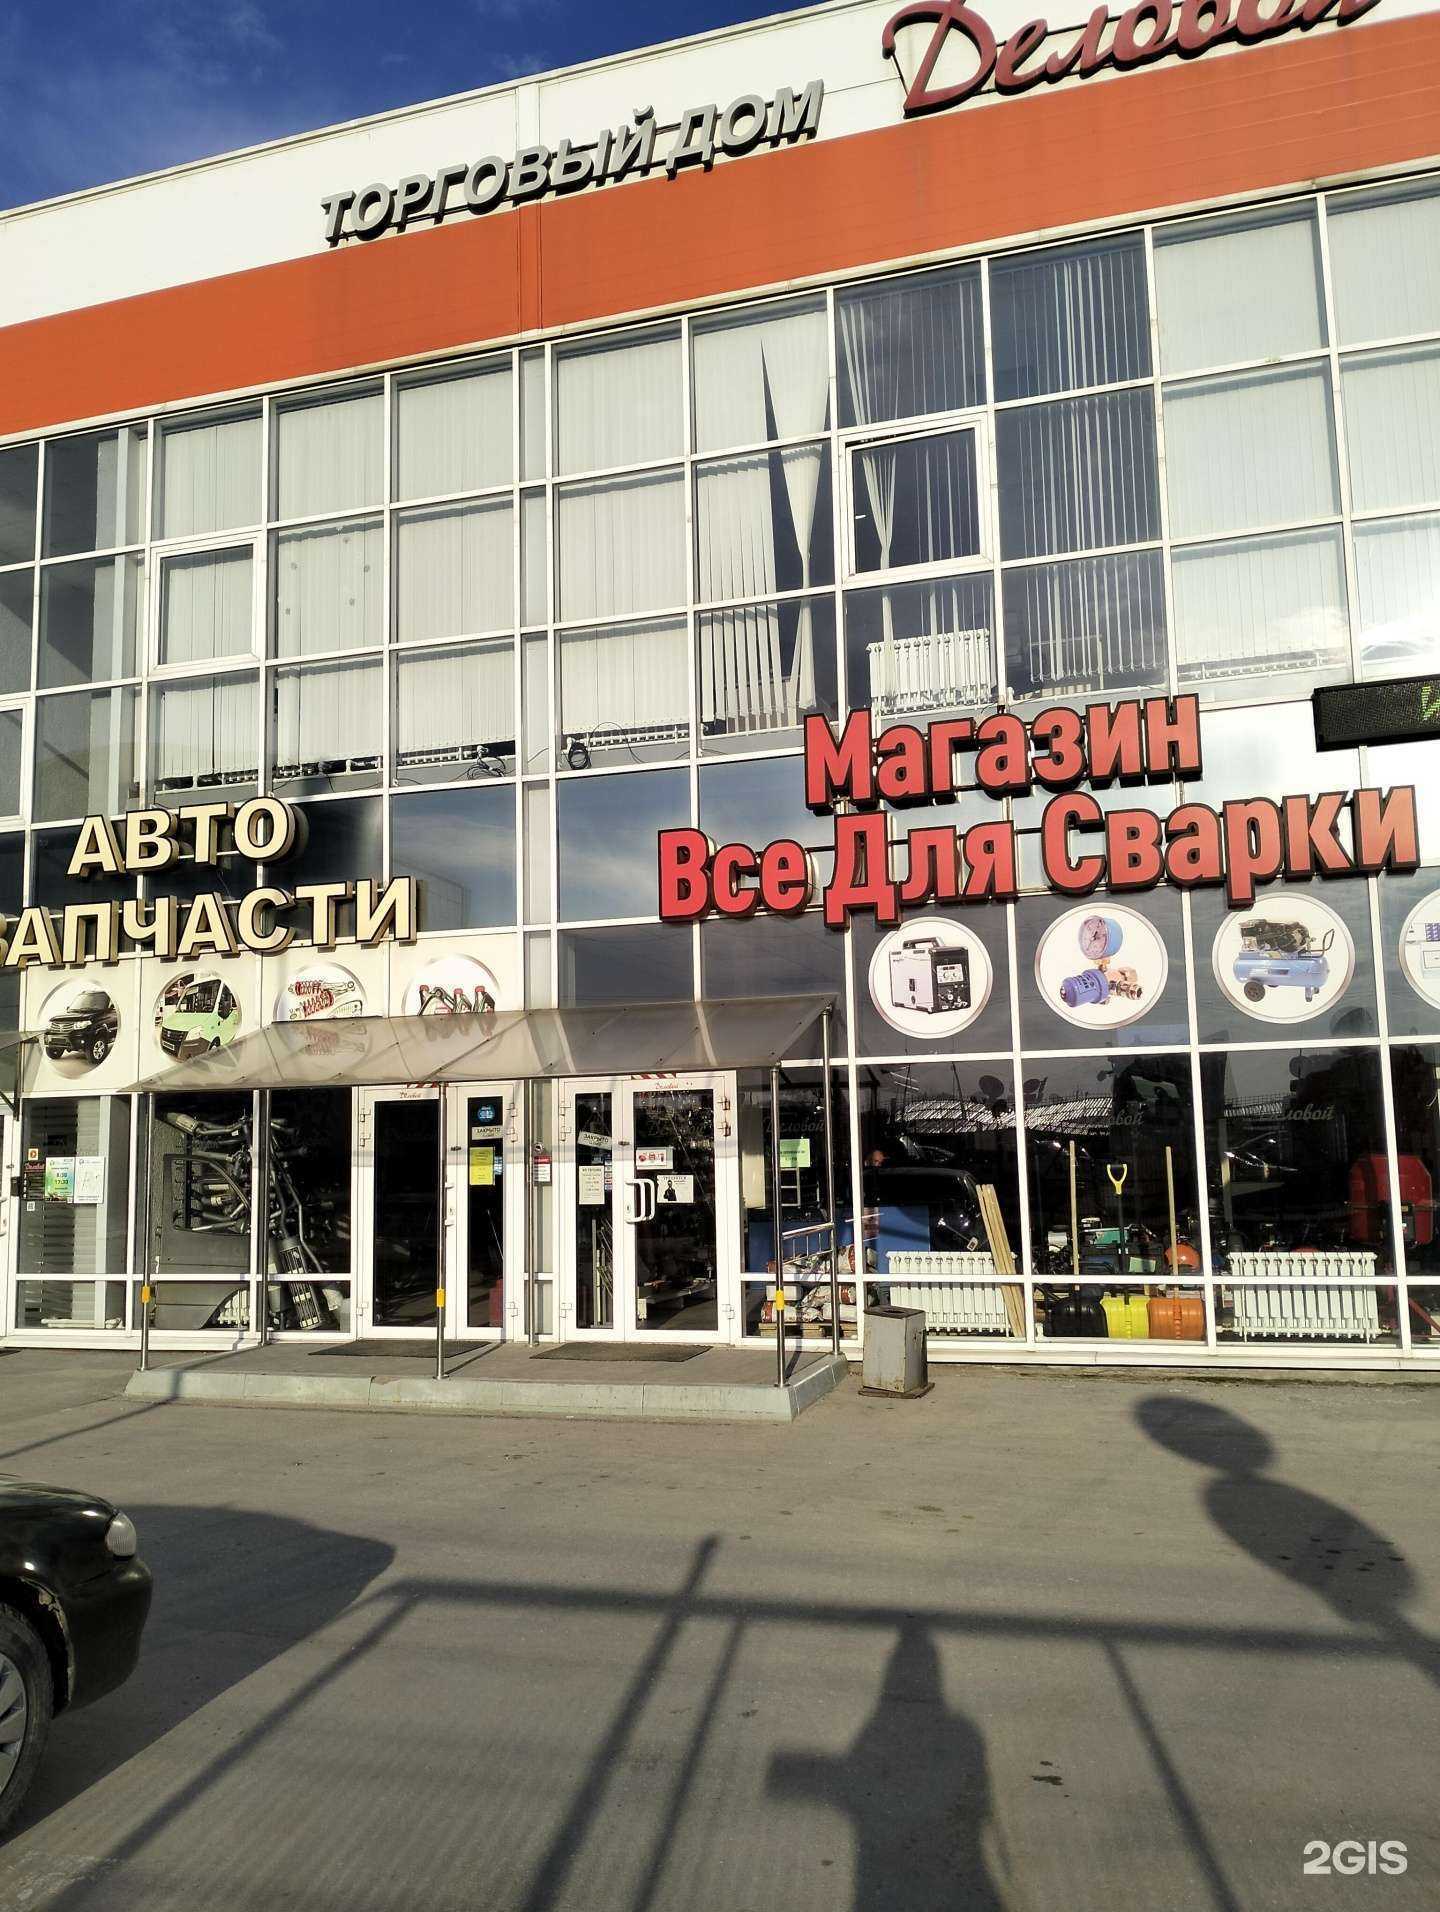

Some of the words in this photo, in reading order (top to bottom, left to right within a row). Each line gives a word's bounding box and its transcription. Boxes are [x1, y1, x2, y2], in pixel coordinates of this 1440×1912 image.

[321, 104, 658, 246] ТОРГОВЫЙ
[665, 79, 825, 180] ДОМ
[804, 692, 1203, 813] Магазин
[66, 796, 300, 878] АВТО
[657, 826, 815, 921] Все
[822, 809, 1020, 929] Для
[1040, 784, 1422, 908] Сварки
[0, 876, 418, 969] АПЧАСТИ
